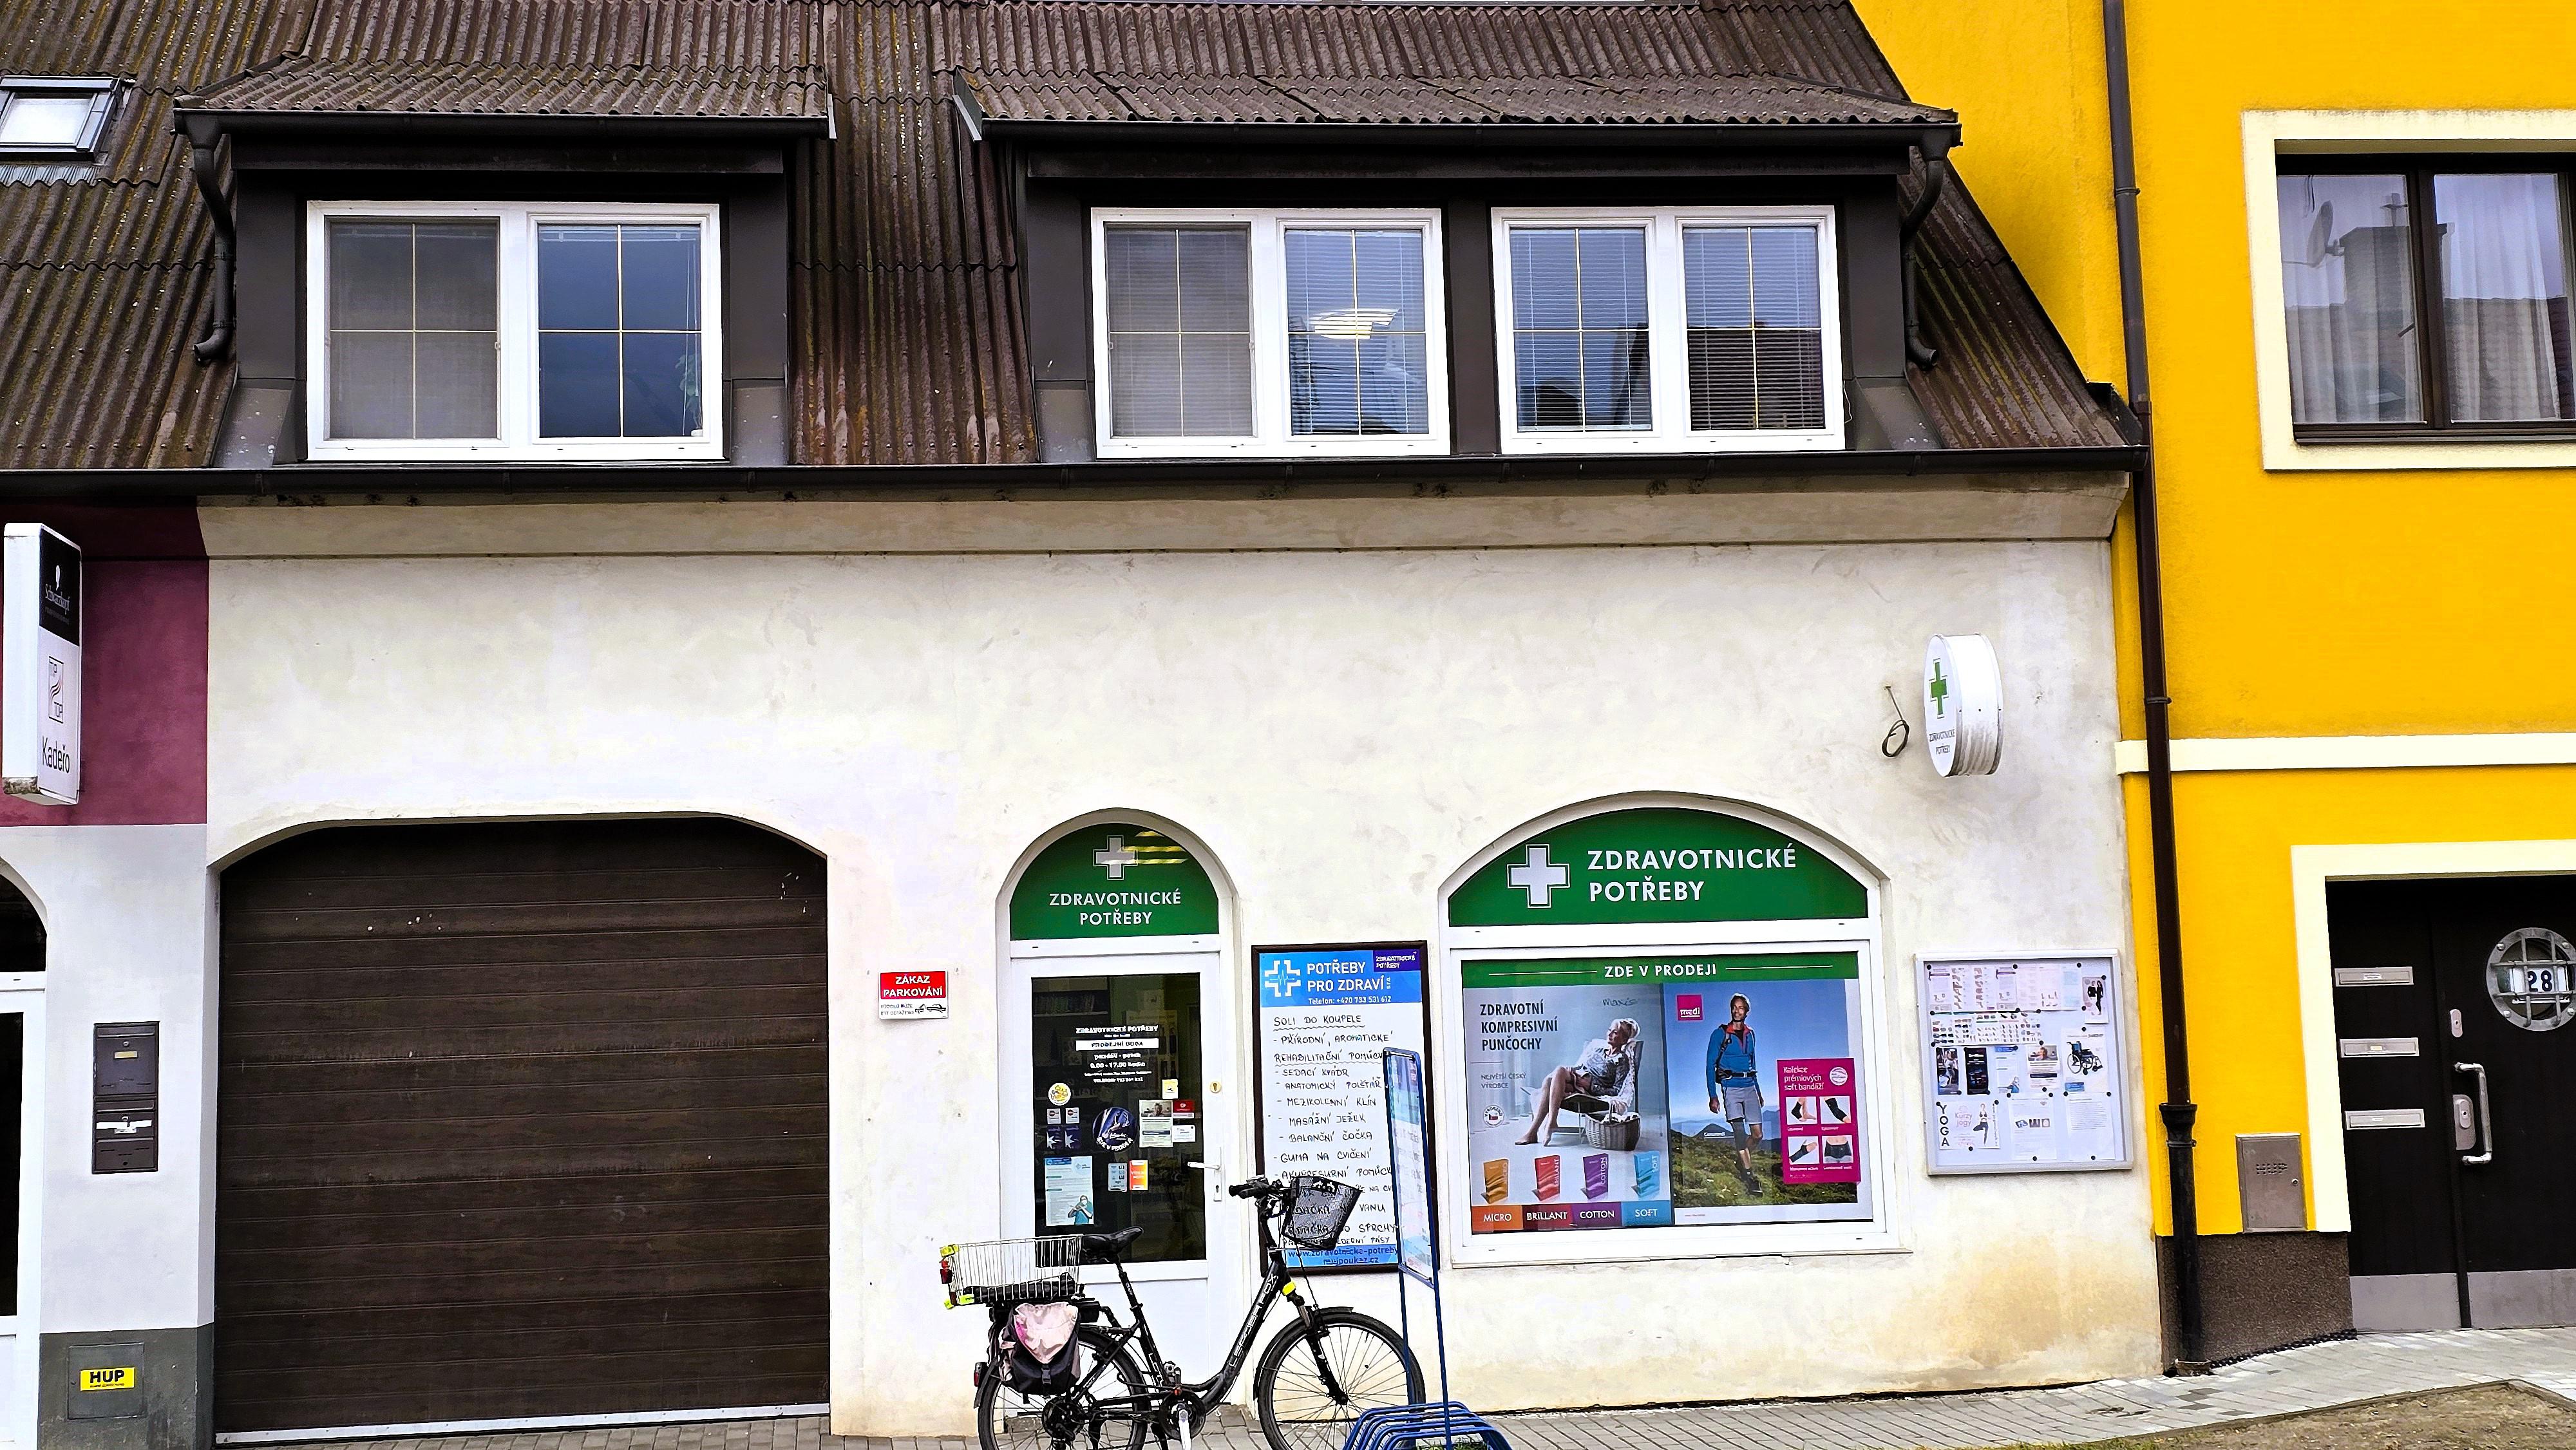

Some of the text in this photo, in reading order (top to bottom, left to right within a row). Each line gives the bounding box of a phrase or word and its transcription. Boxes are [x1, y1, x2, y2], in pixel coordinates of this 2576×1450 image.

[1587, 843, 1797, 871] ZDRAVOTNICKÉ
[1589, 875, 1705, 902] POTŘEBY
[1048, 888, 1182, 906] ZDRAVOTNICKÉ
[1079, 909, 1153, 925] POTŘEBY
[1307, 959, 1366, 975] POTŘEBY
[1604, 964, 1716, 978] ZDE V PRODEJI
[895, 974, 931, 984] ZÁKAZ
[1307, 979, 1334, 992] PRO
[1338, 975, 1385, 991] ZDRAVÍ
[2527, 970, 2553, 992] 28
[883, 986, 943, 997] PARKOVÁNÍ
[1480, 999, 1544, 1016] ZDRAVOTNÍ
[1273, 1016, 1296, 1026] SOLI
[1323, 1015, 1361, 1024] KOUPELE
[1481, 1016, 1558, 1033] KOMPRESIVNÍ
[1482, 1035, 1542, 1051] PUNČOCHY
[1282, 1066, 1350, 1077] SEDACÍ KVÁDR
[1285, 1079, 1336, 1090] ANATOMICKÝ
[1784, 1074, 1822, 1084] prémiových
[1356, 1095, 1377, 1106] KLÍN
[1289, 1112, 1331, 1126] MASÁŽNÍ
[1289, 1131, 1372, 1143] BALANČNÍ ČOČKA
[1280, 1147, 1372, 1163] GUMA NA CVIČENÍ
[1359, 1203, 1386, 1213] VANU
[1634, 1209, 1658, 1218] SOFT
[1483, 1213, 1512, 1223] MICRO
[1526, 1210, 1567, 1221] BRILLANT
[1580, 1210, 1615, 1219] COTTON
[1359, 1223, 1396, 1233] SPRCHY
[1370, 1235, 1390, 1243] PÁSY
[90, 1370, 125, 1384] HUP
